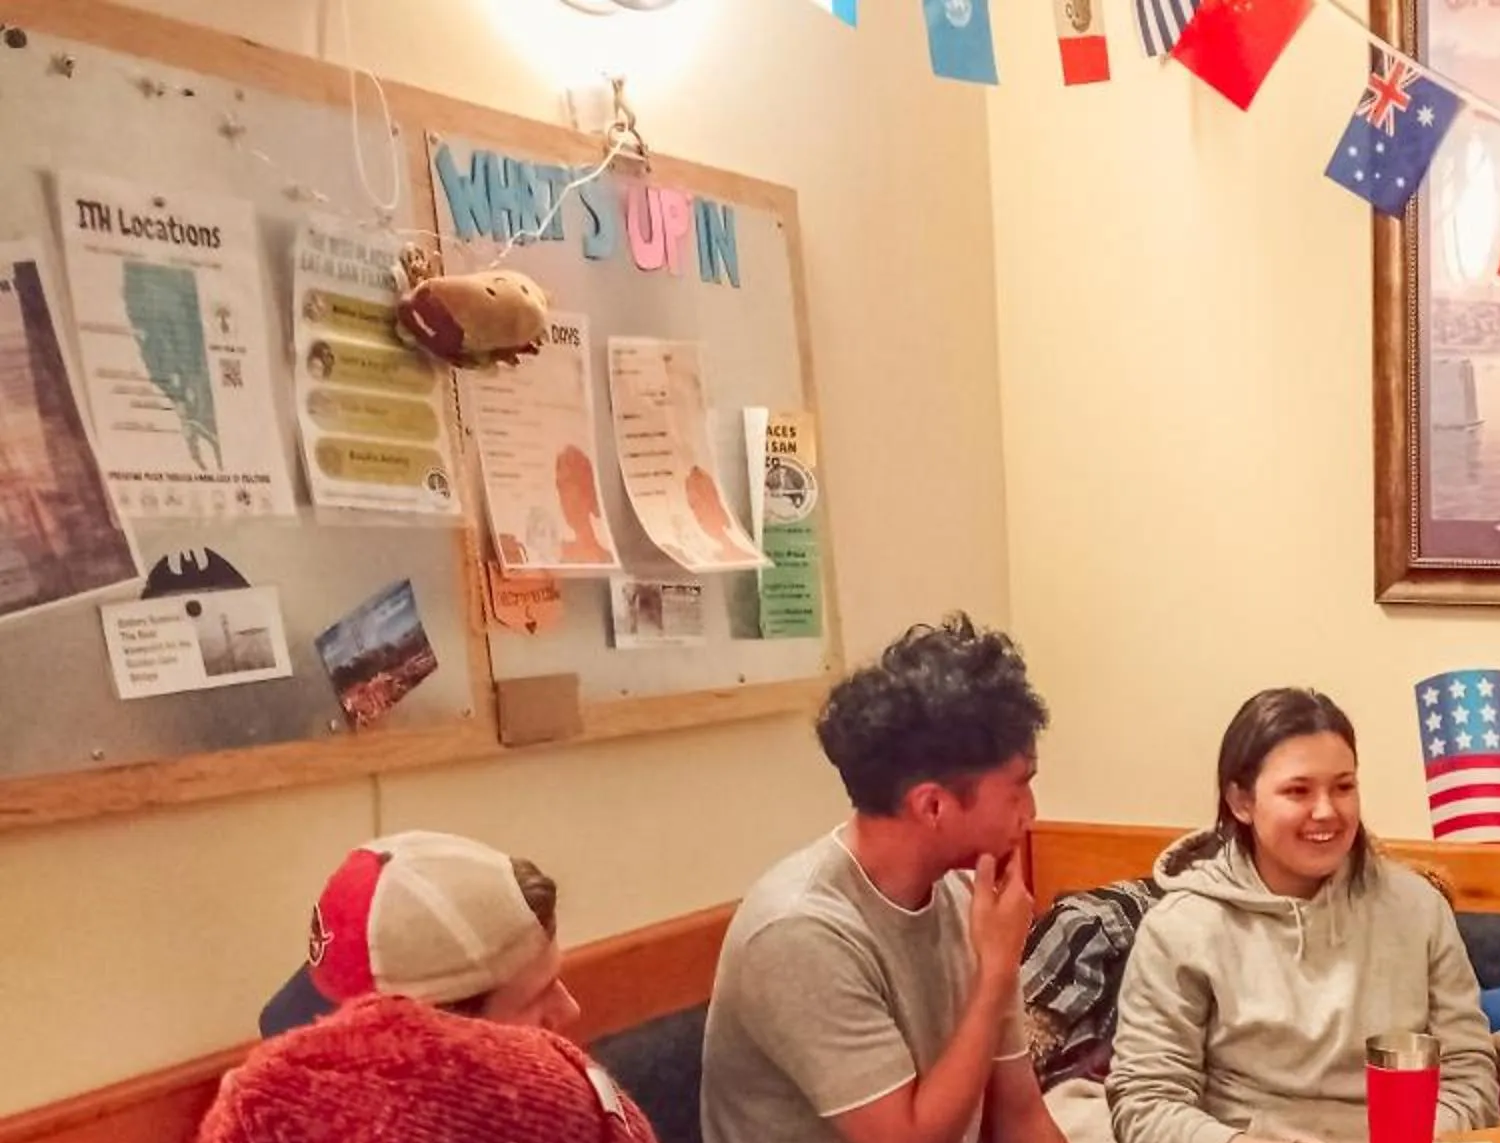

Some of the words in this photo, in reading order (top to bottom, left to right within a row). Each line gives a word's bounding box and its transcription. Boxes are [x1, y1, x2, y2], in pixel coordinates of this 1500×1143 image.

[76, 198, 111, 231] ITH
[118, 207, 222, 249] Locations
[625, 183, 693, 278] UP
[694, 195, 742, 289] IN
